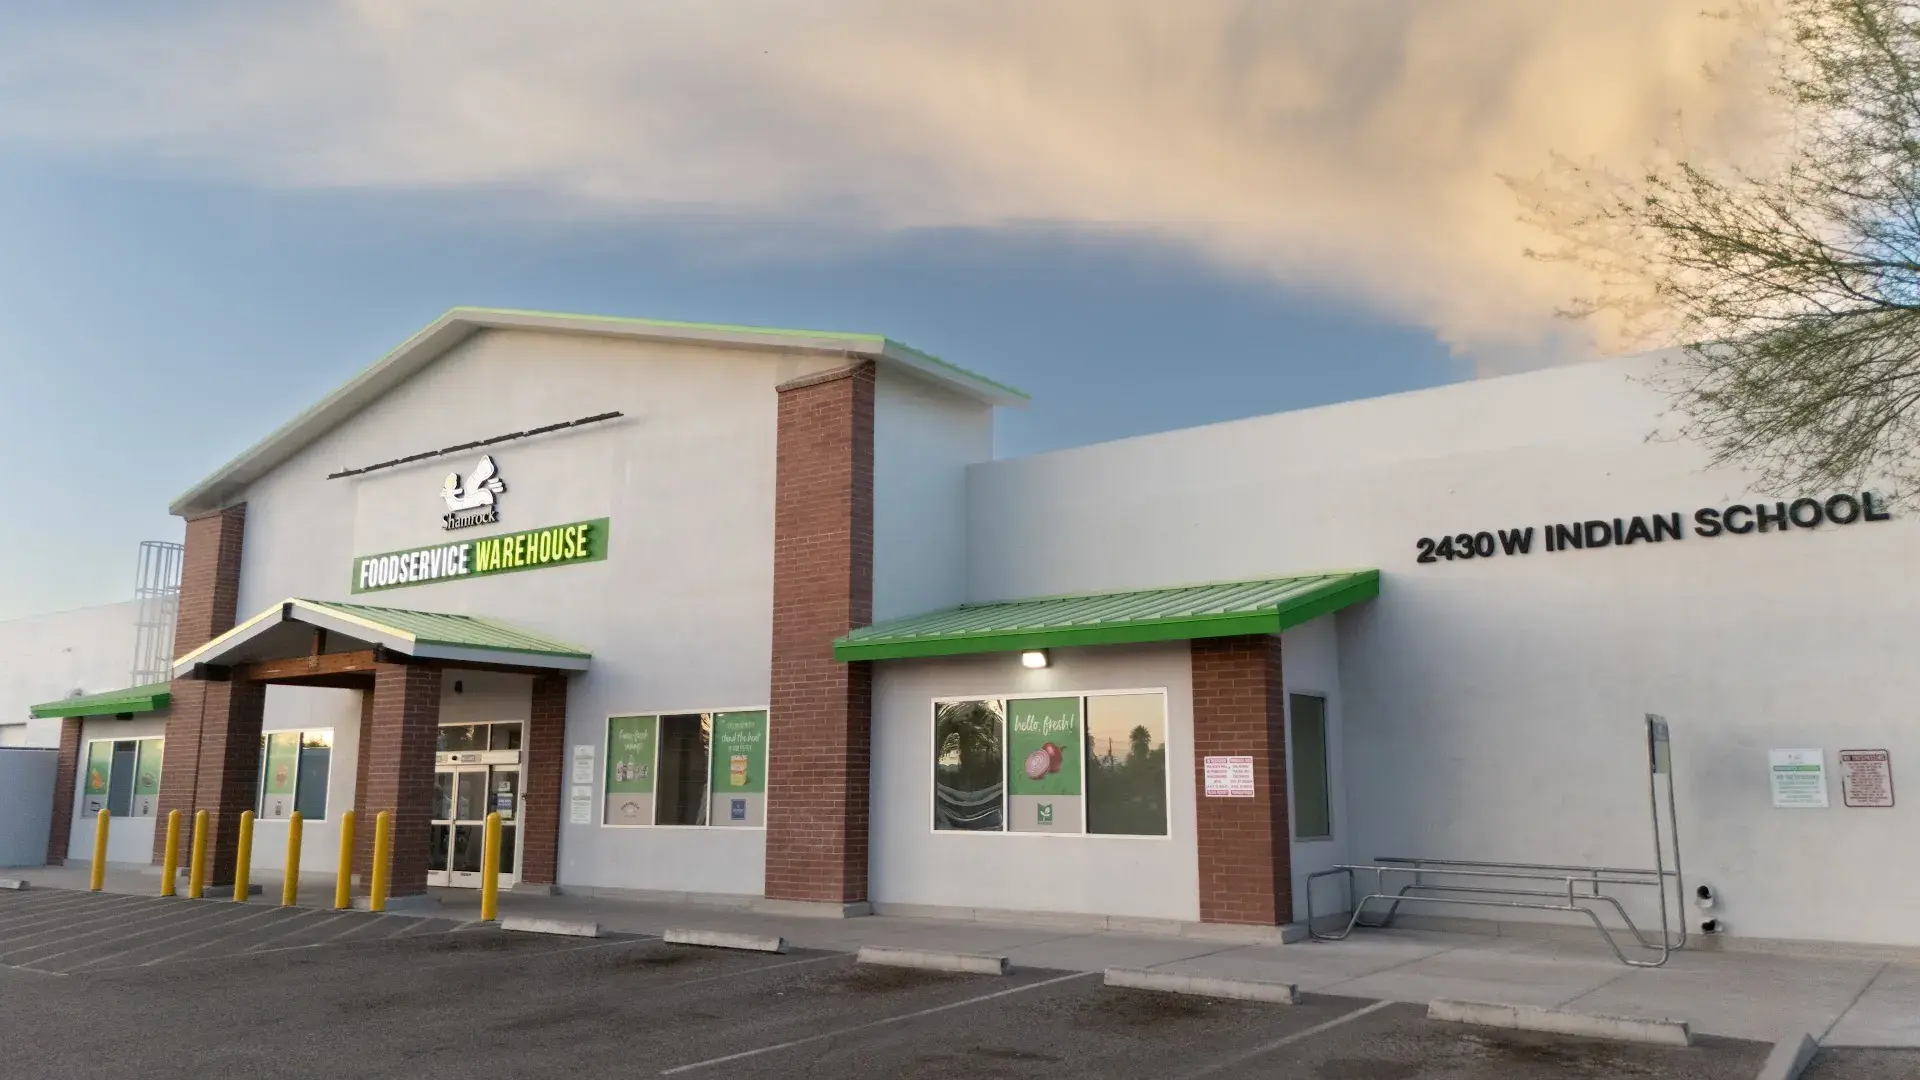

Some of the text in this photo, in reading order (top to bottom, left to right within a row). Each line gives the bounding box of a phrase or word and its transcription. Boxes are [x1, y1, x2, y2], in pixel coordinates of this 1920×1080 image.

[442, 504, 498, 530] Shamrock
[1416, 491, 1891, 563] 2430 W INDIAN SCHOOL
[360, 524, 589, 589] FOODSERVICE WAREHOUSE
[1042, 713, 1074, 736] fresh!
